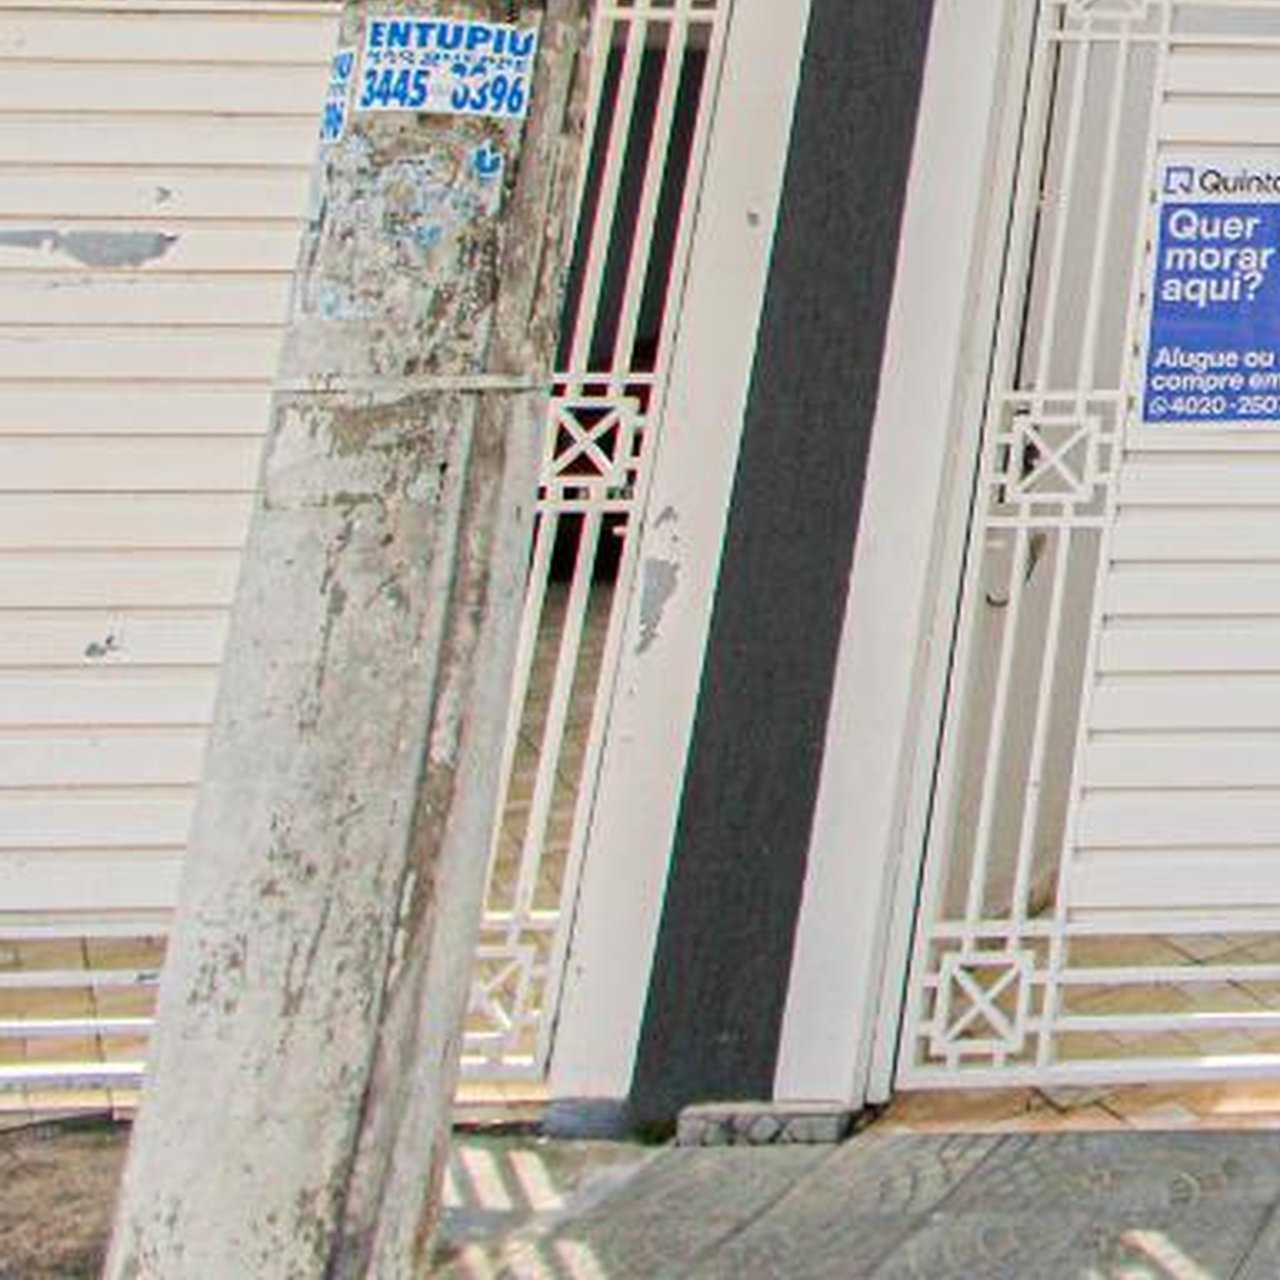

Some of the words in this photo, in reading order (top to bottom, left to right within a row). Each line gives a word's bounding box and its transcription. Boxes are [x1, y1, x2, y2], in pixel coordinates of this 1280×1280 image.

[361, 68, 430, 108] 3445
[1168, 208, 1262, 240] Quer
[1165, 247, 1276, 271] morar
[1161, 271, 1264, 308] aqui?
[1153, 346, 1239, 374] Alugue
[1244, 350, 1275, 368] ou
[1151, 373, 1245, 394] compre
